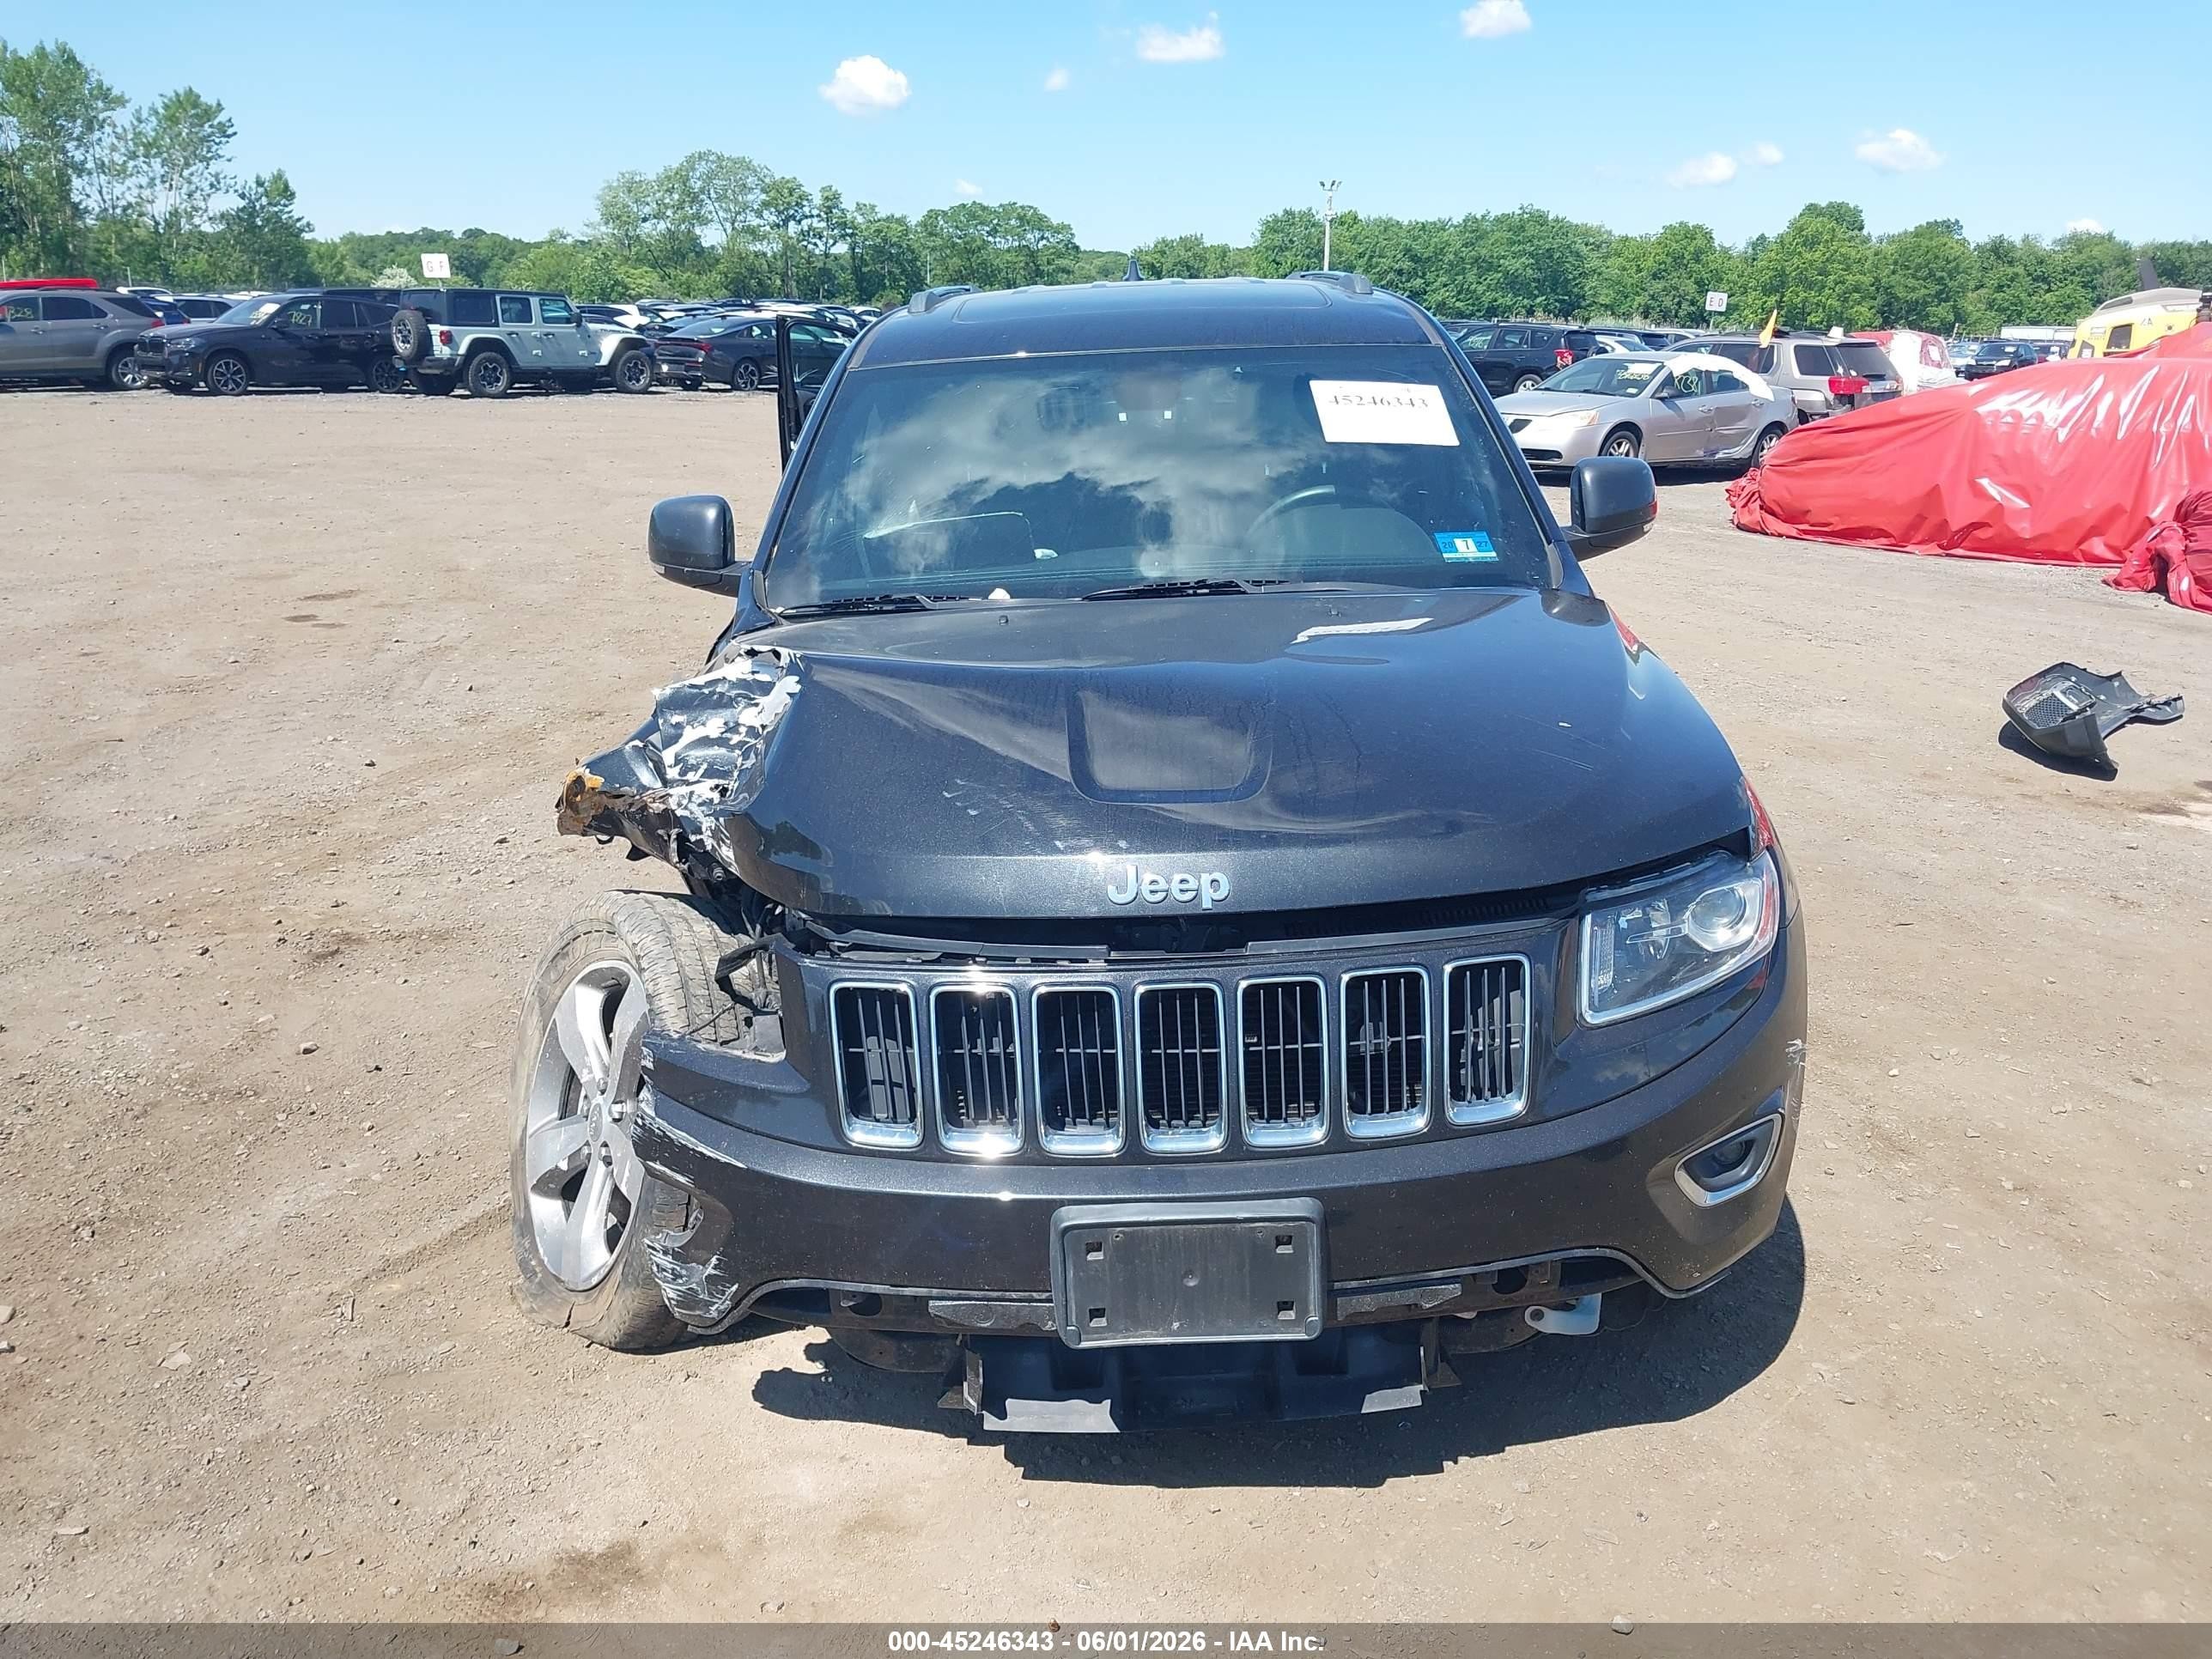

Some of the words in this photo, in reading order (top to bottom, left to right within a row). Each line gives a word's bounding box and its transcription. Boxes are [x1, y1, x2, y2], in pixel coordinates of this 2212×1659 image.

[426, 260, 434, 273] G
[439, 260, 445, 273] F
[1709, 296, 1714, 307] E
[1717, 297, 1724, 307] D
[1328, 395, 1429, 408] 45246343
[1442, 541, 1454, 550] 20
[1461, 539, 1470, 550] 7
[1107, 865, 1231, 910] Jeep
